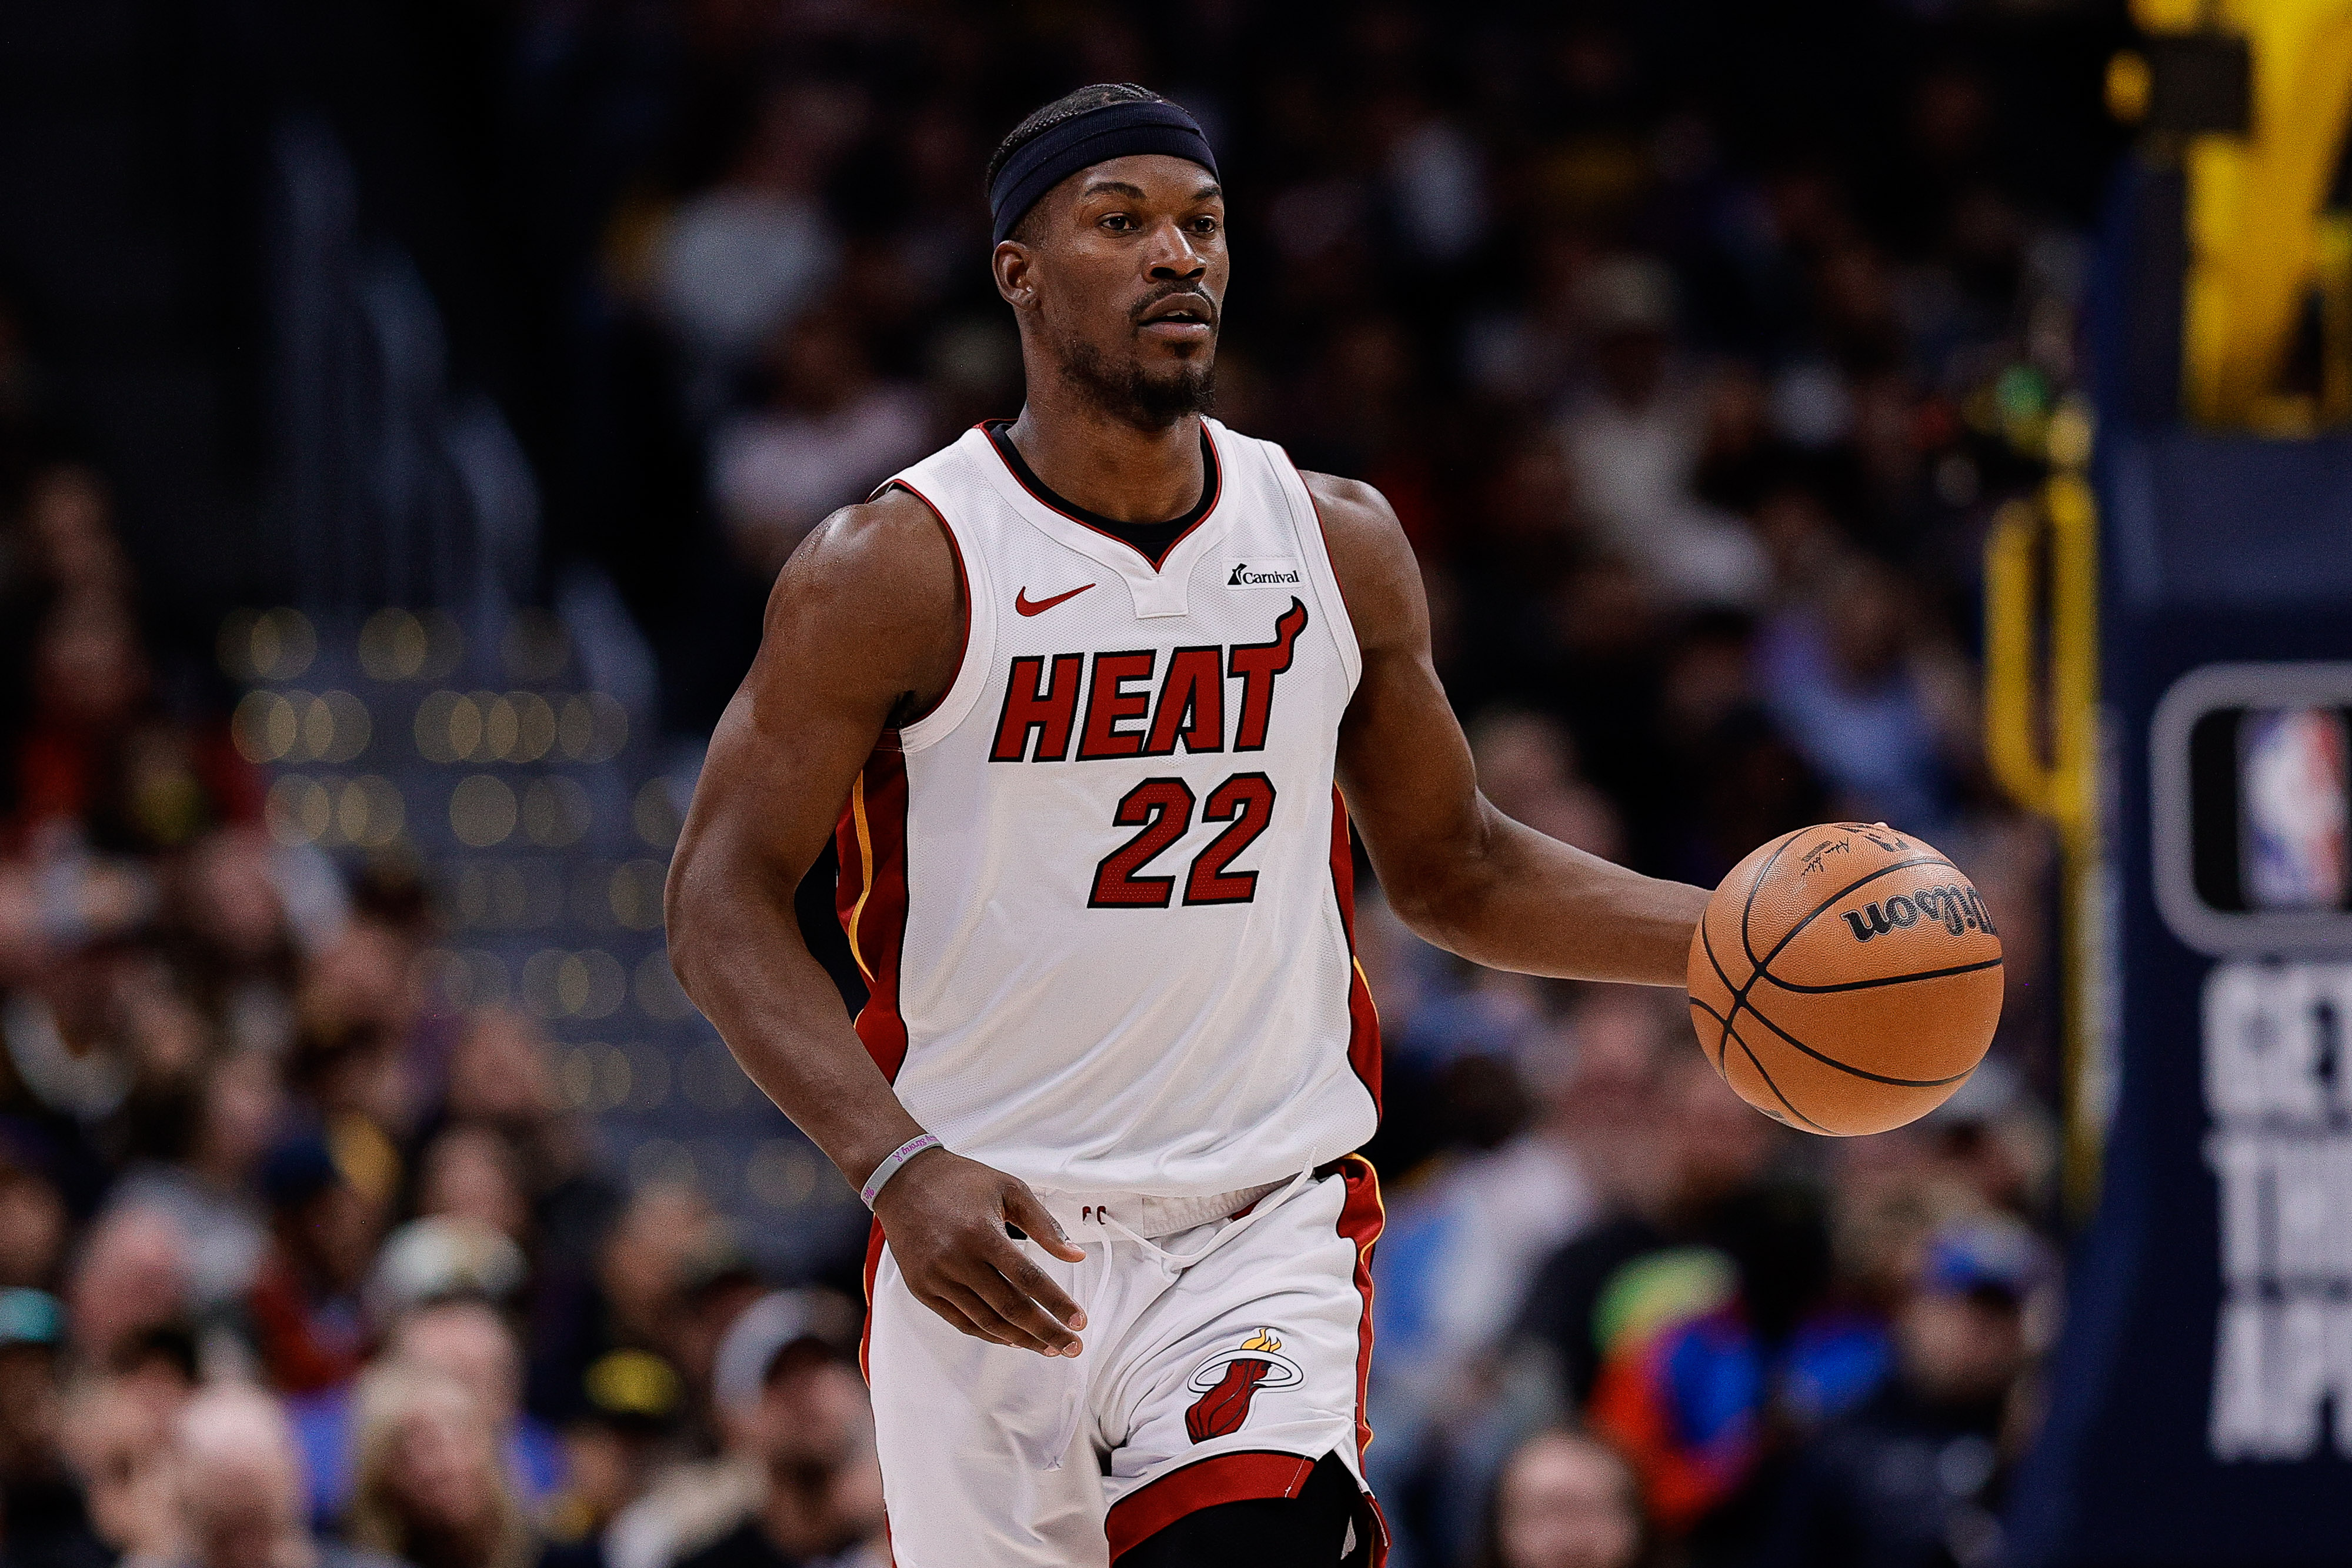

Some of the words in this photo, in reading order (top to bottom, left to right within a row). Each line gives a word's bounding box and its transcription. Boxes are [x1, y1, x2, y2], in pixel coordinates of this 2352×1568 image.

[1242, 570, 1300, 585] Carnival
[988, 595, 1309, 763] HEAT
[1087, 771, 1277, 909] 22
[901, 1138, 928, 1155] Strong
